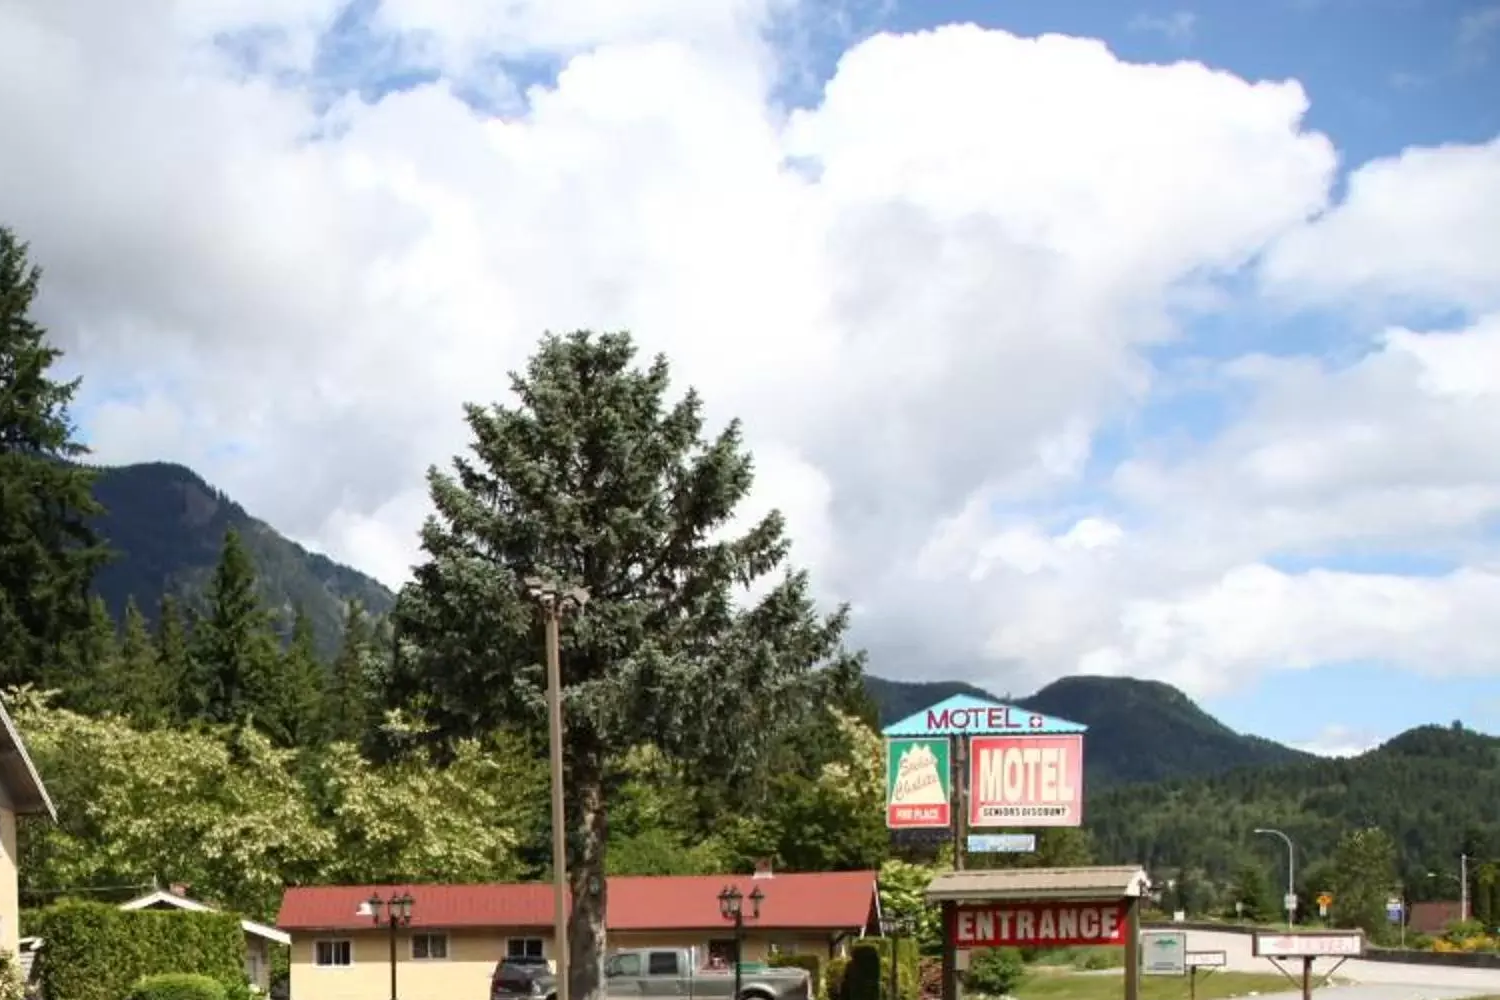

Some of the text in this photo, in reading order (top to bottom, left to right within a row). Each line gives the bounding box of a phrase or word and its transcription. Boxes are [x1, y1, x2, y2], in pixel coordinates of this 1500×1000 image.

[927, 707, 1022, 729] MOTEL
[979, 747, 1075, 802] MOTEL
[957, 907, 1120, 941] ENTRANCE
